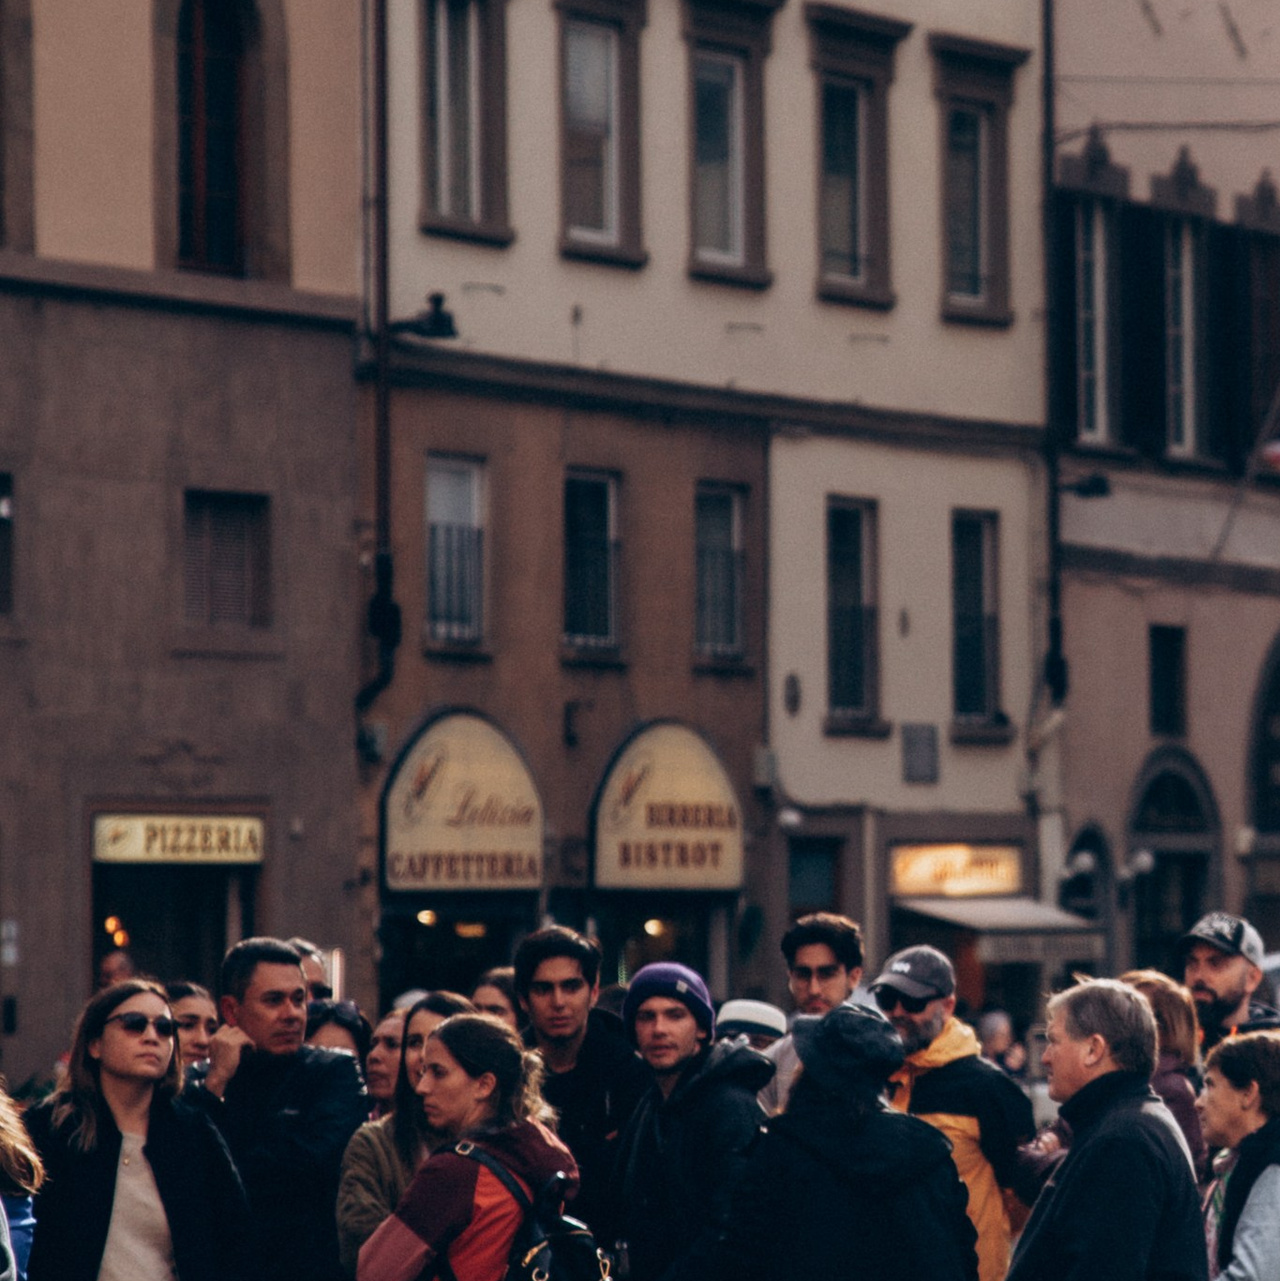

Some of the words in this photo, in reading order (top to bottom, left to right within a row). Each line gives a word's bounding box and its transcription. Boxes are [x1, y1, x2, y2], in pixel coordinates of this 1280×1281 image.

[144, 824, 259, 854] PIZZERIA
[387, 851, 538, 882] CAFFETTERIA
[619, 842, 723, 868] BISTROT
